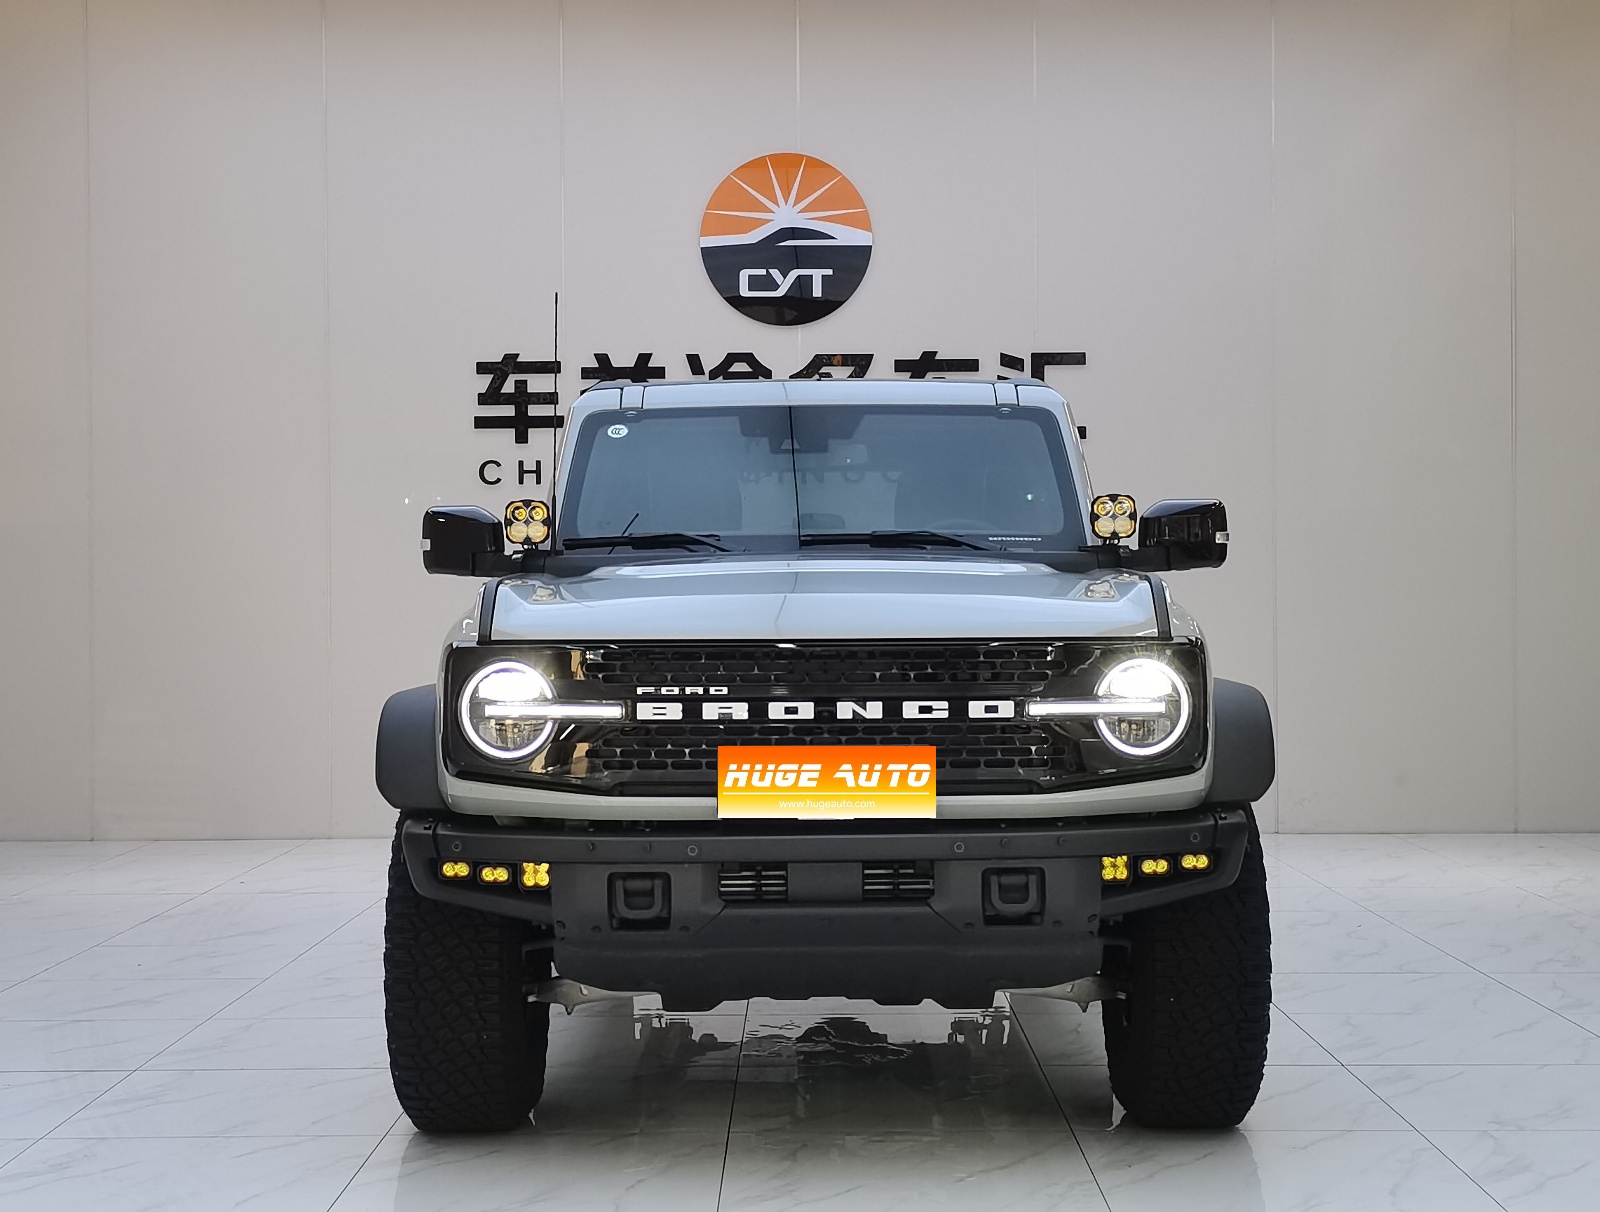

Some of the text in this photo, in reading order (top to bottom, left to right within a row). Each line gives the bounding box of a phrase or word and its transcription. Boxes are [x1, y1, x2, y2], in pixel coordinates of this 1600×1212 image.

[739, 268, 833, 297] CYT
[636, 686, 729, 695] FORD
[636, 701, 1015, 720] BRONCO
